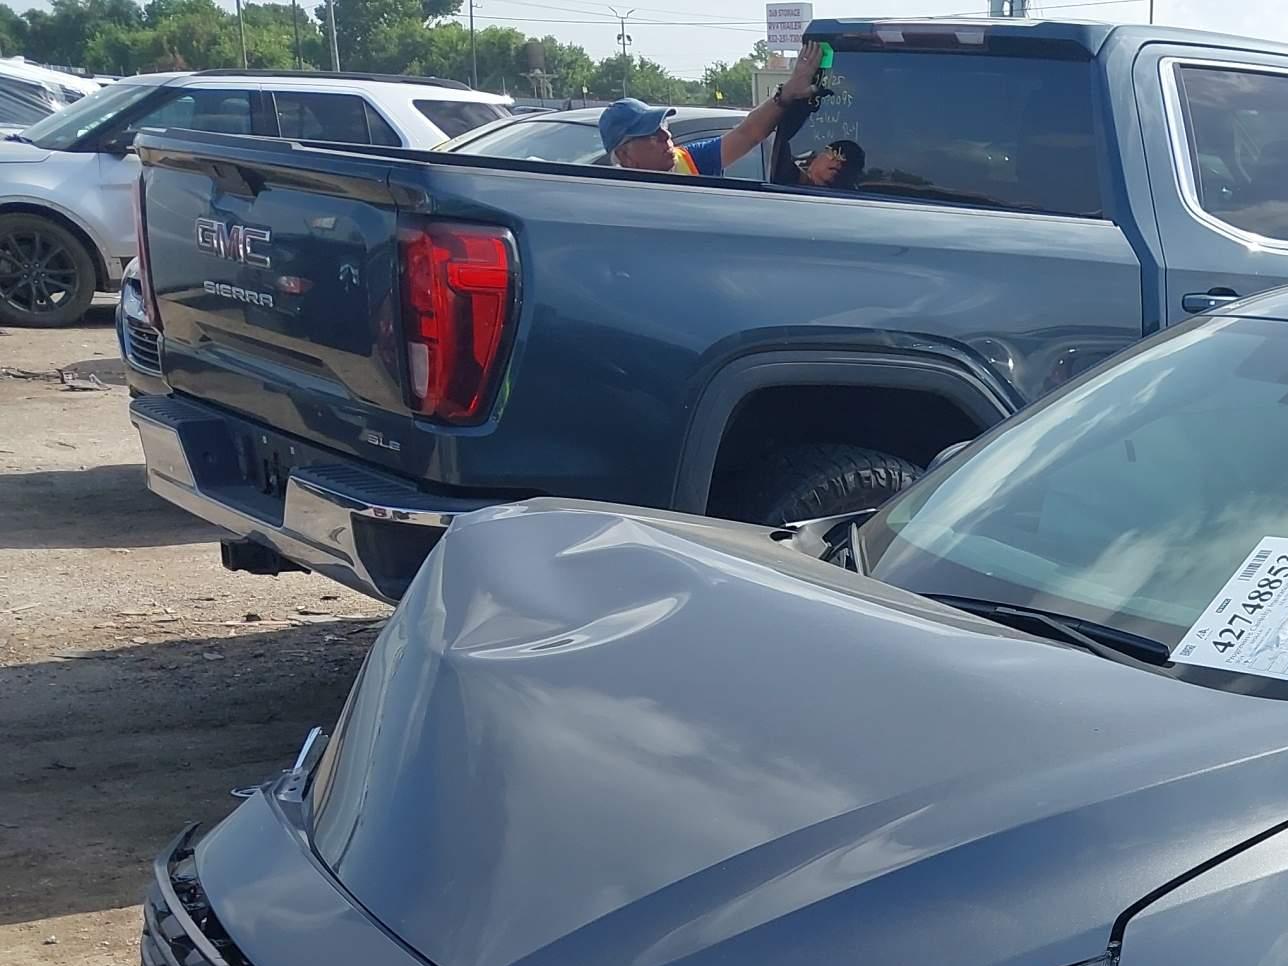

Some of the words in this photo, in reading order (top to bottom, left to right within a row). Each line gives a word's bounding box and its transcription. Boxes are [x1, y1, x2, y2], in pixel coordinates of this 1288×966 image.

[194, 217, 272, 269] GMC
[203, 280, 274, 308] SIERRA
[367, 433, 401, 451] SLE
